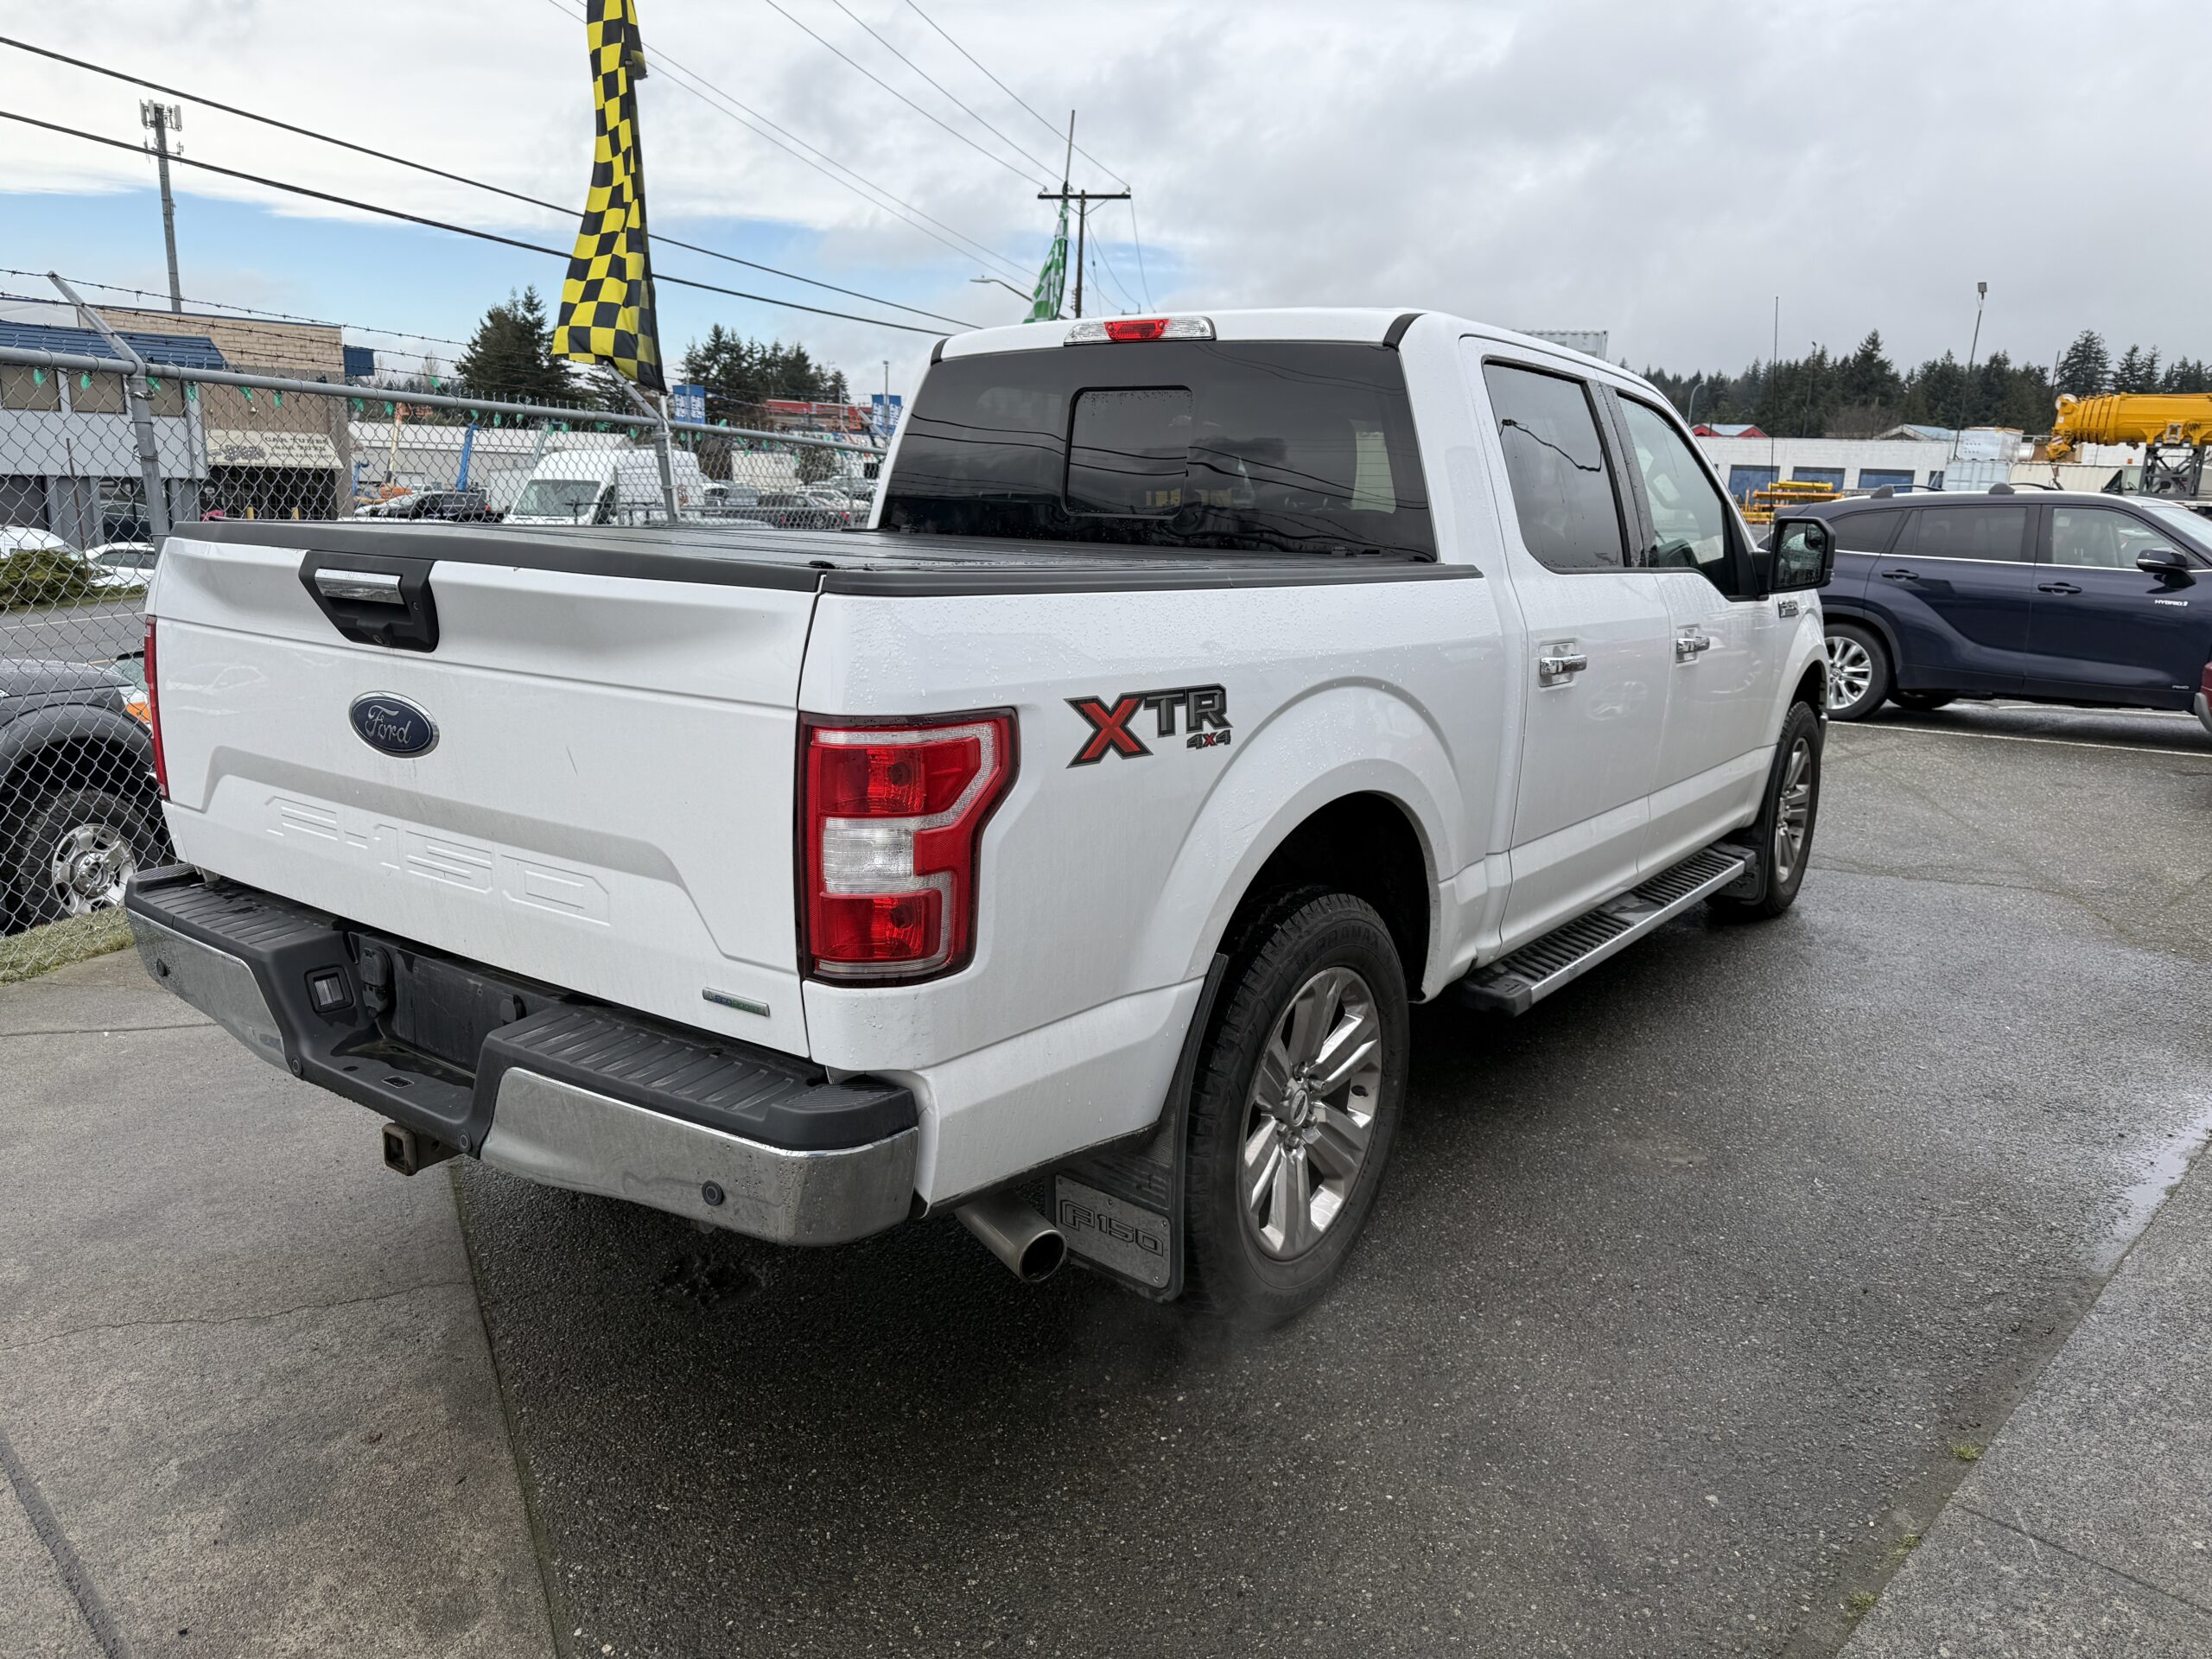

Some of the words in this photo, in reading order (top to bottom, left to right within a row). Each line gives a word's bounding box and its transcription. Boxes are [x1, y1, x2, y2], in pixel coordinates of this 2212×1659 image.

[365, 705, 412, 744] Ford
[1064, 683, 1234, 769] XTR
[264, 795, 612, 927] F-150
[1059, 1198, 1164, 1258] F150
